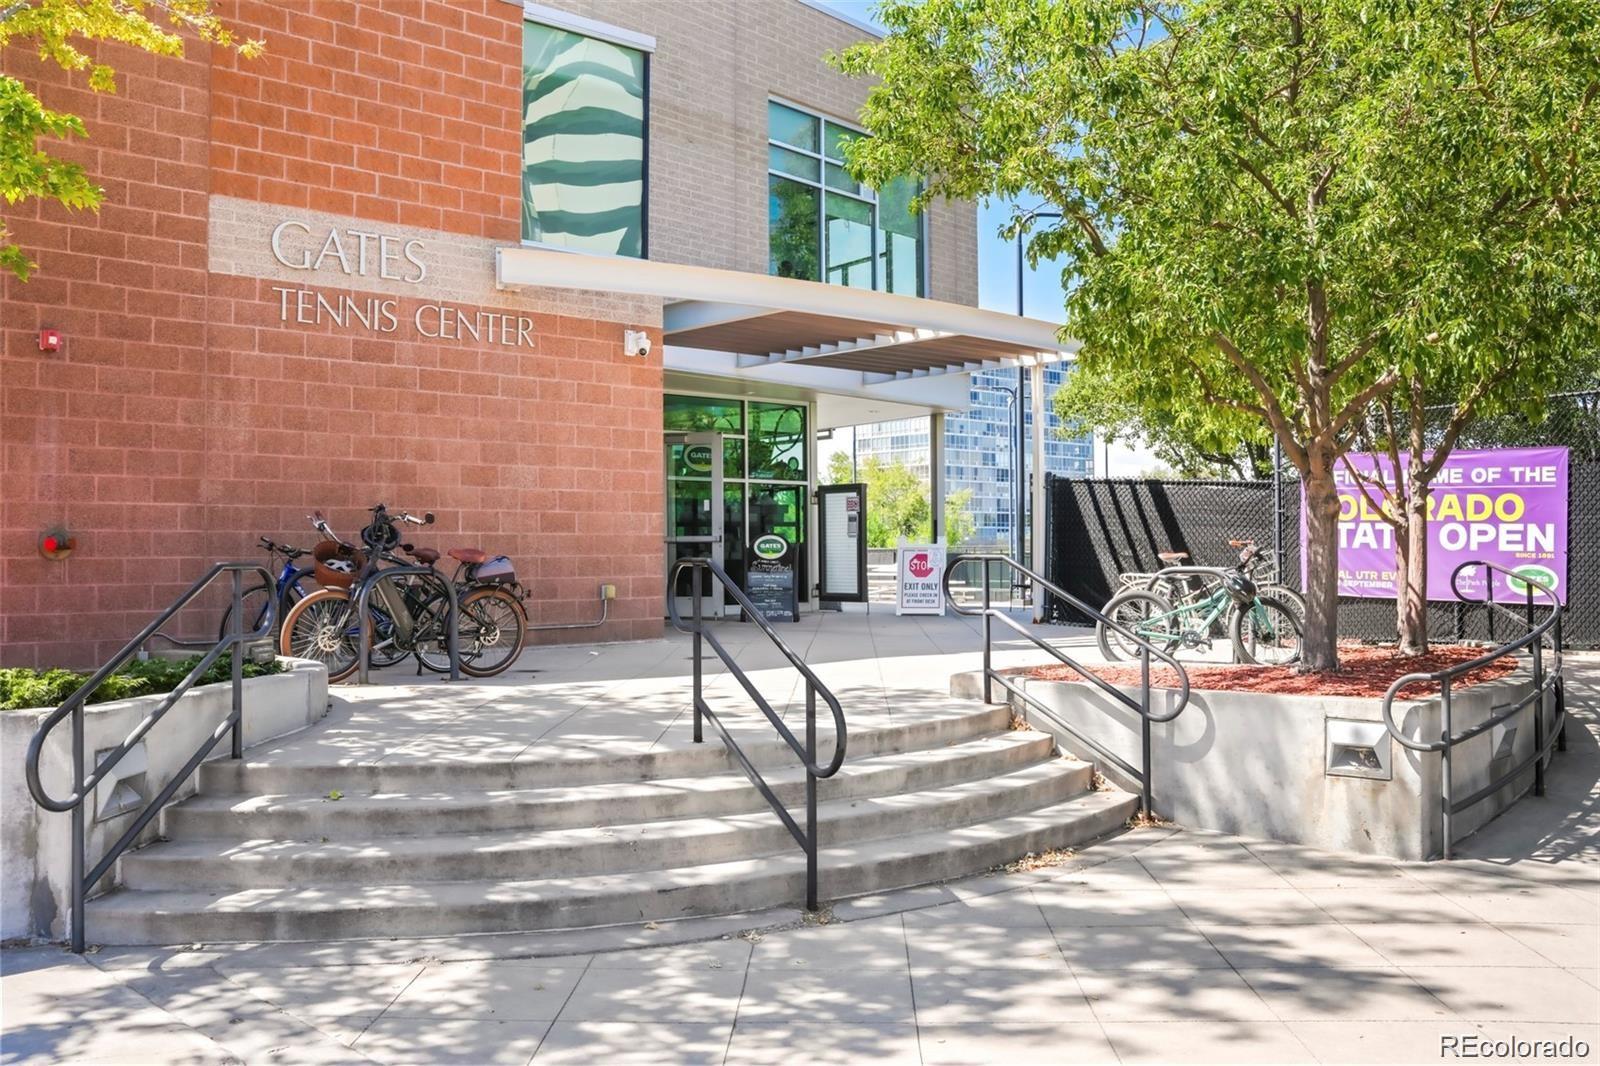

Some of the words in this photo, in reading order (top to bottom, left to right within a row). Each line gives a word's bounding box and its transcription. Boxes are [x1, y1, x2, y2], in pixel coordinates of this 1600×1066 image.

[270, 219, 427, 284] GATES
[271, 285, 399, 333] TENNIS
[414, 303, 536, 348] CENTER
[1471, 467, 1502, 484] OF
[1510, 466, 1557, 482] THE
[1338, 493, 1525, 522] OLRADO
[1337, 522, 1395, 549] TAT
[1439, 522, 1555, 552] OPEN
[904, 582, 919, 591] EXIT
[921, 582, 938, 591] ONLY
[1343, 580, 1393, 588] SEPTEMBER
[1382, 571, 1397, 580] EV
